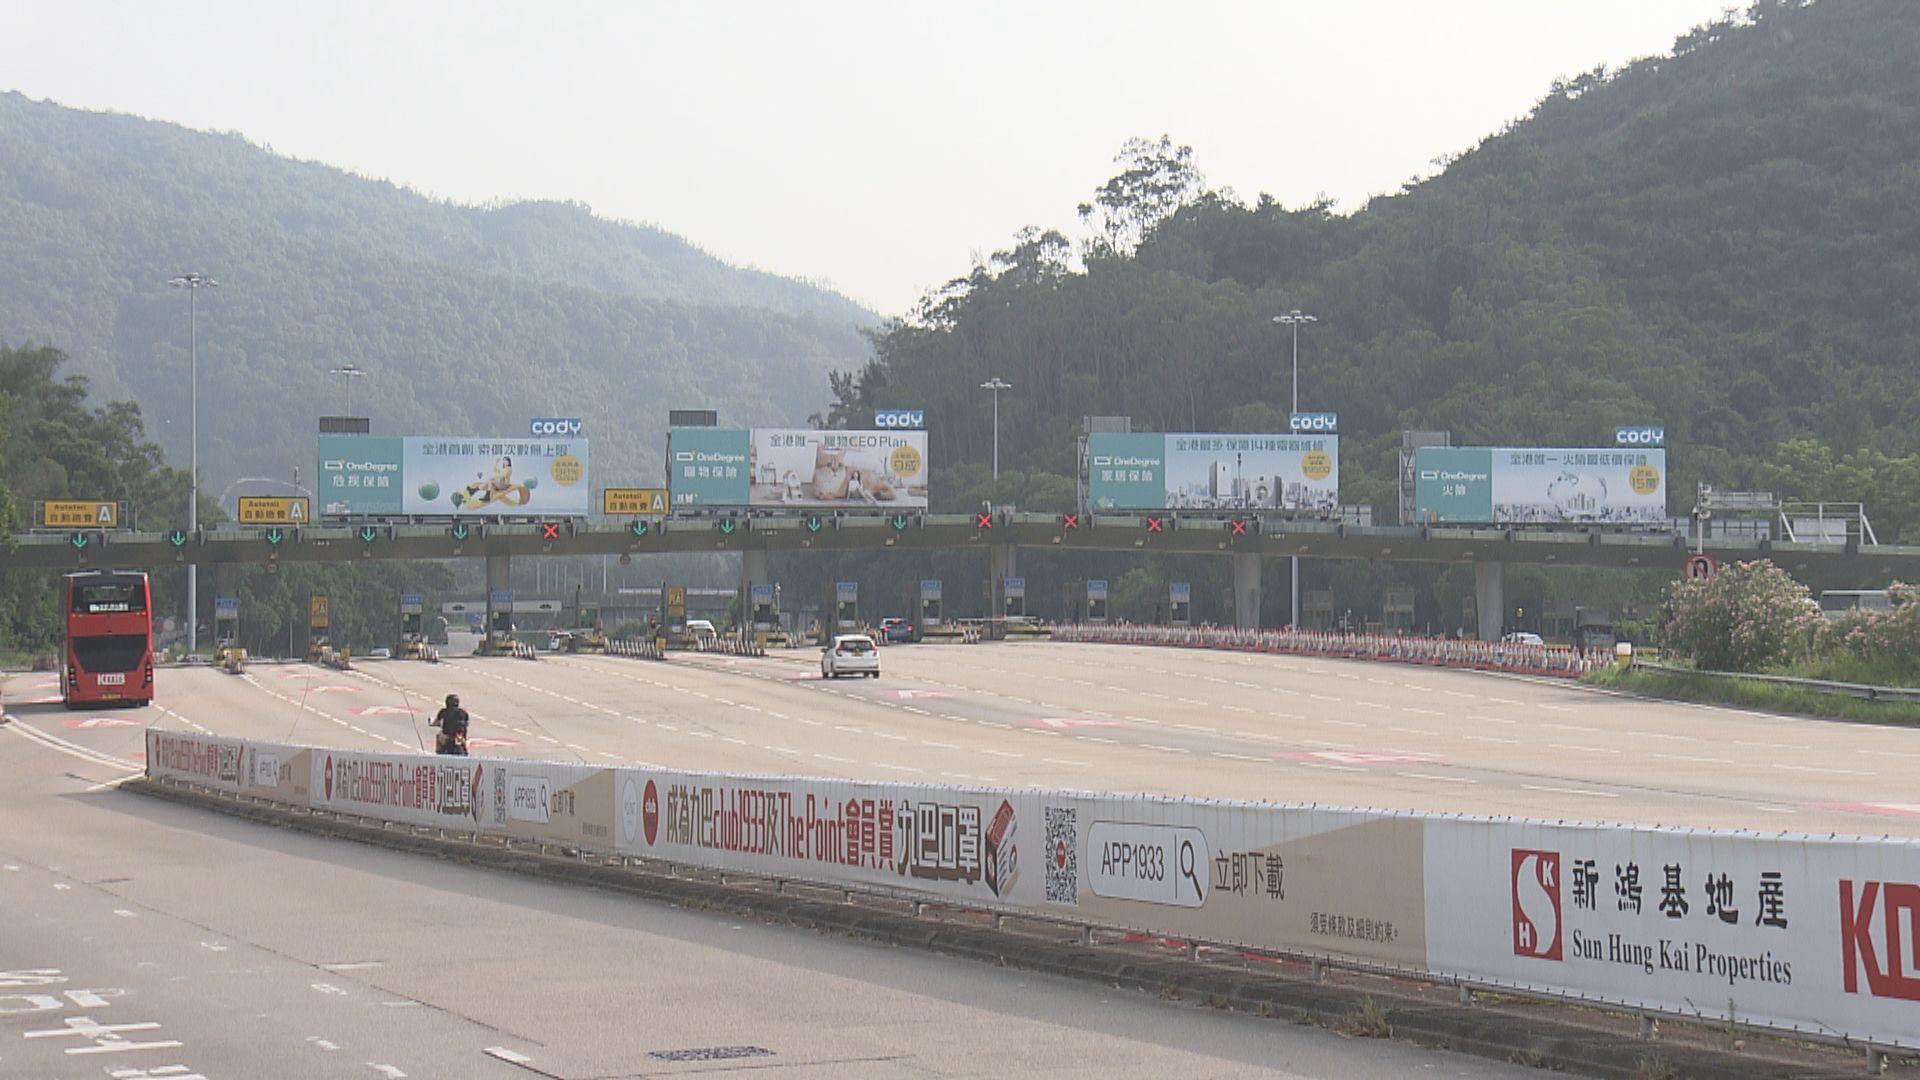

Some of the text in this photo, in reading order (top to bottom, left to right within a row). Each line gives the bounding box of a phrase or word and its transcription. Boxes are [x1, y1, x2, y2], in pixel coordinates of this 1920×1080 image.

[531, 420, 582, 435] cody
[875, 412, 924, 429] cody
[1290, 416, 1337, 431] cody
[879, 435, 908, 448] Plan
[1616, 429, 1664, 444] cody
[696, 452, 745, 465] OneDegree
[1113, 457, 1161, 468] OneDegree
[346, 461, 398, 473] OneDegree
[1440, 471, 1488, 482] OneDegree
[652, 494, 664, 511] A
[98, 505, 112, 522] A
[290, 502, 304, 519] A
[1101, 840, 1166, 882] APP1933
[1214, 849, 1286, 900] 立即下載
[1572, 928, 1792, 985] Sun Hung Kai Properties
